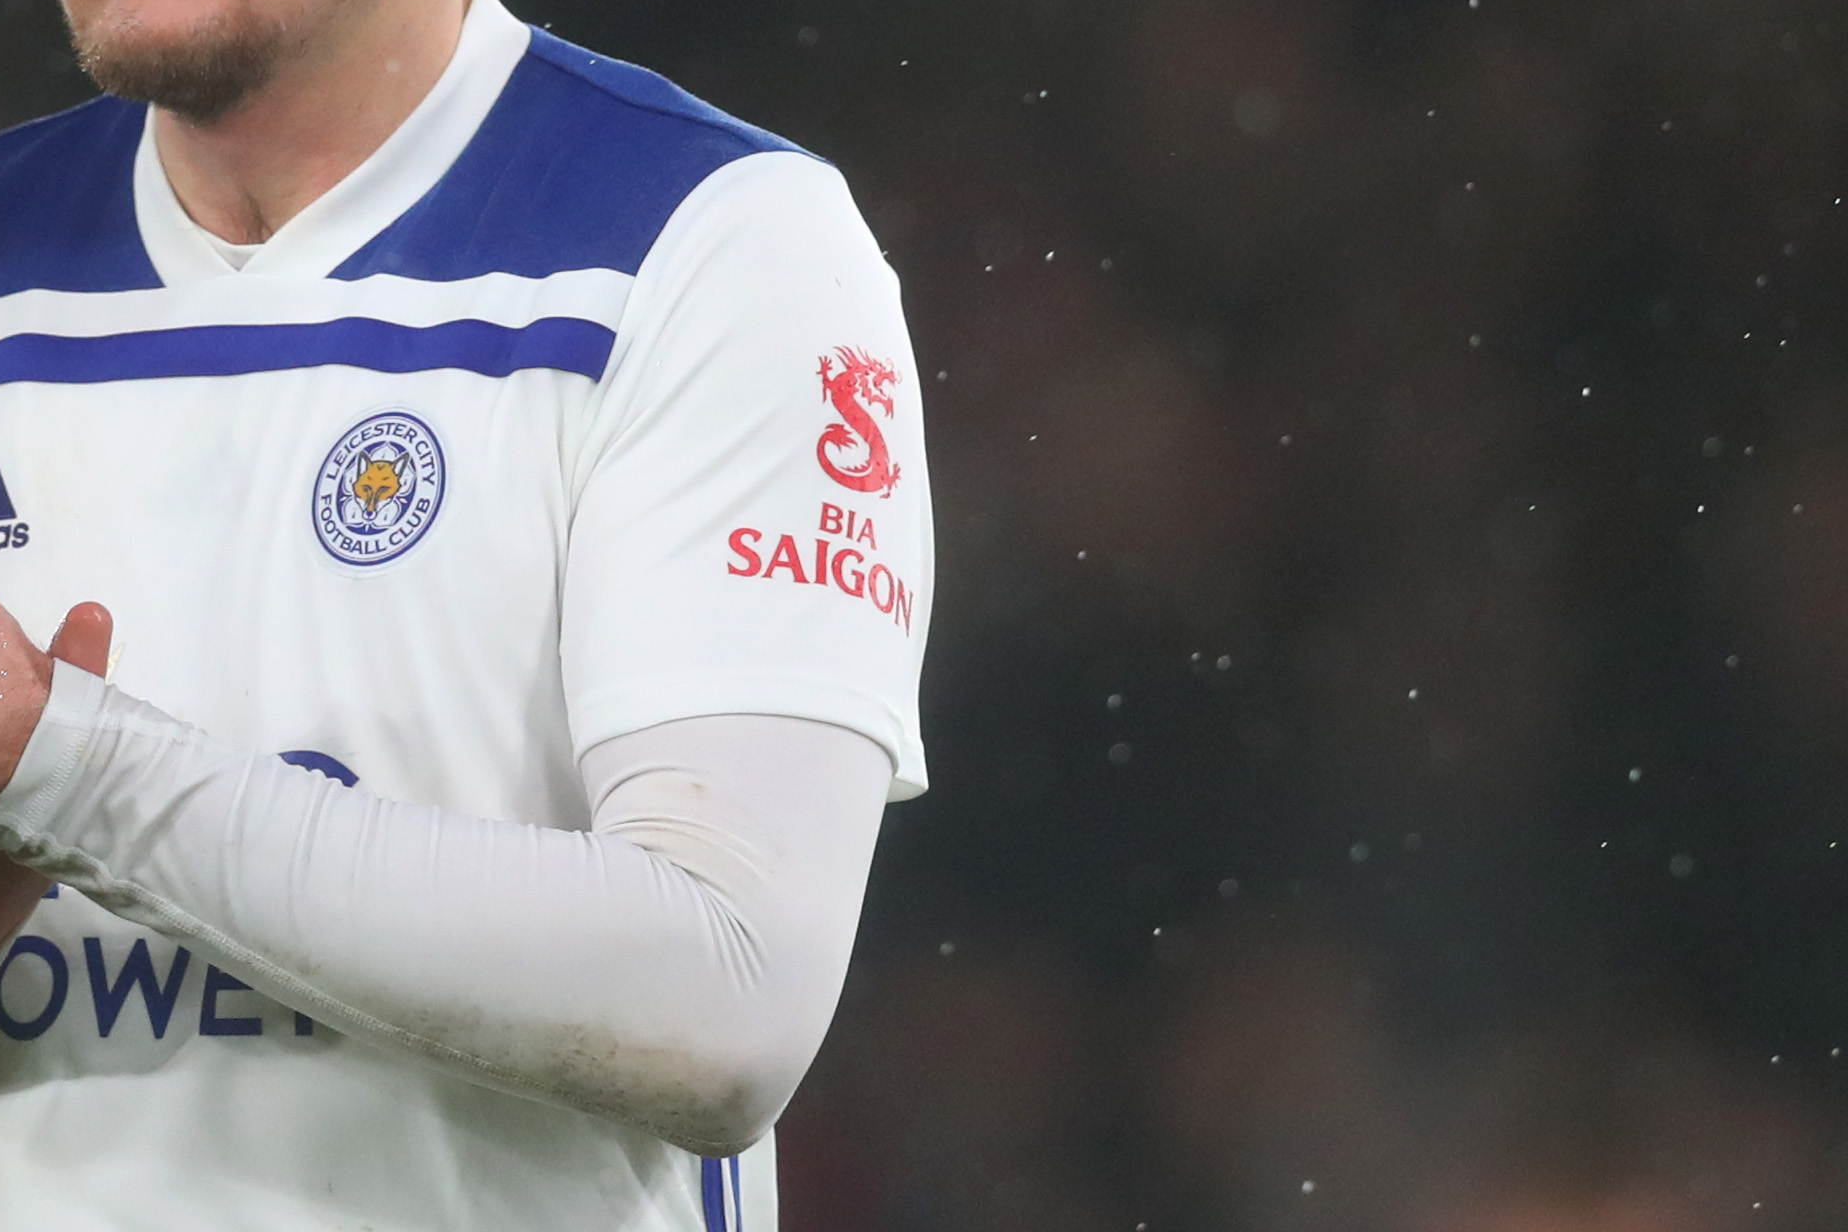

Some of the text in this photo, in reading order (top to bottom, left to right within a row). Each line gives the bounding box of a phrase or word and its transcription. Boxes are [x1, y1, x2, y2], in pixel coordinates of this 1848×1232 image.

[326, 422, 435, 486] LEICESTER CITY
[321, 493, 430, 554] FOOTBALL CLUB
[819, 501, 877, 550] BIA
[727, 527, 913, 637] SAIGON
